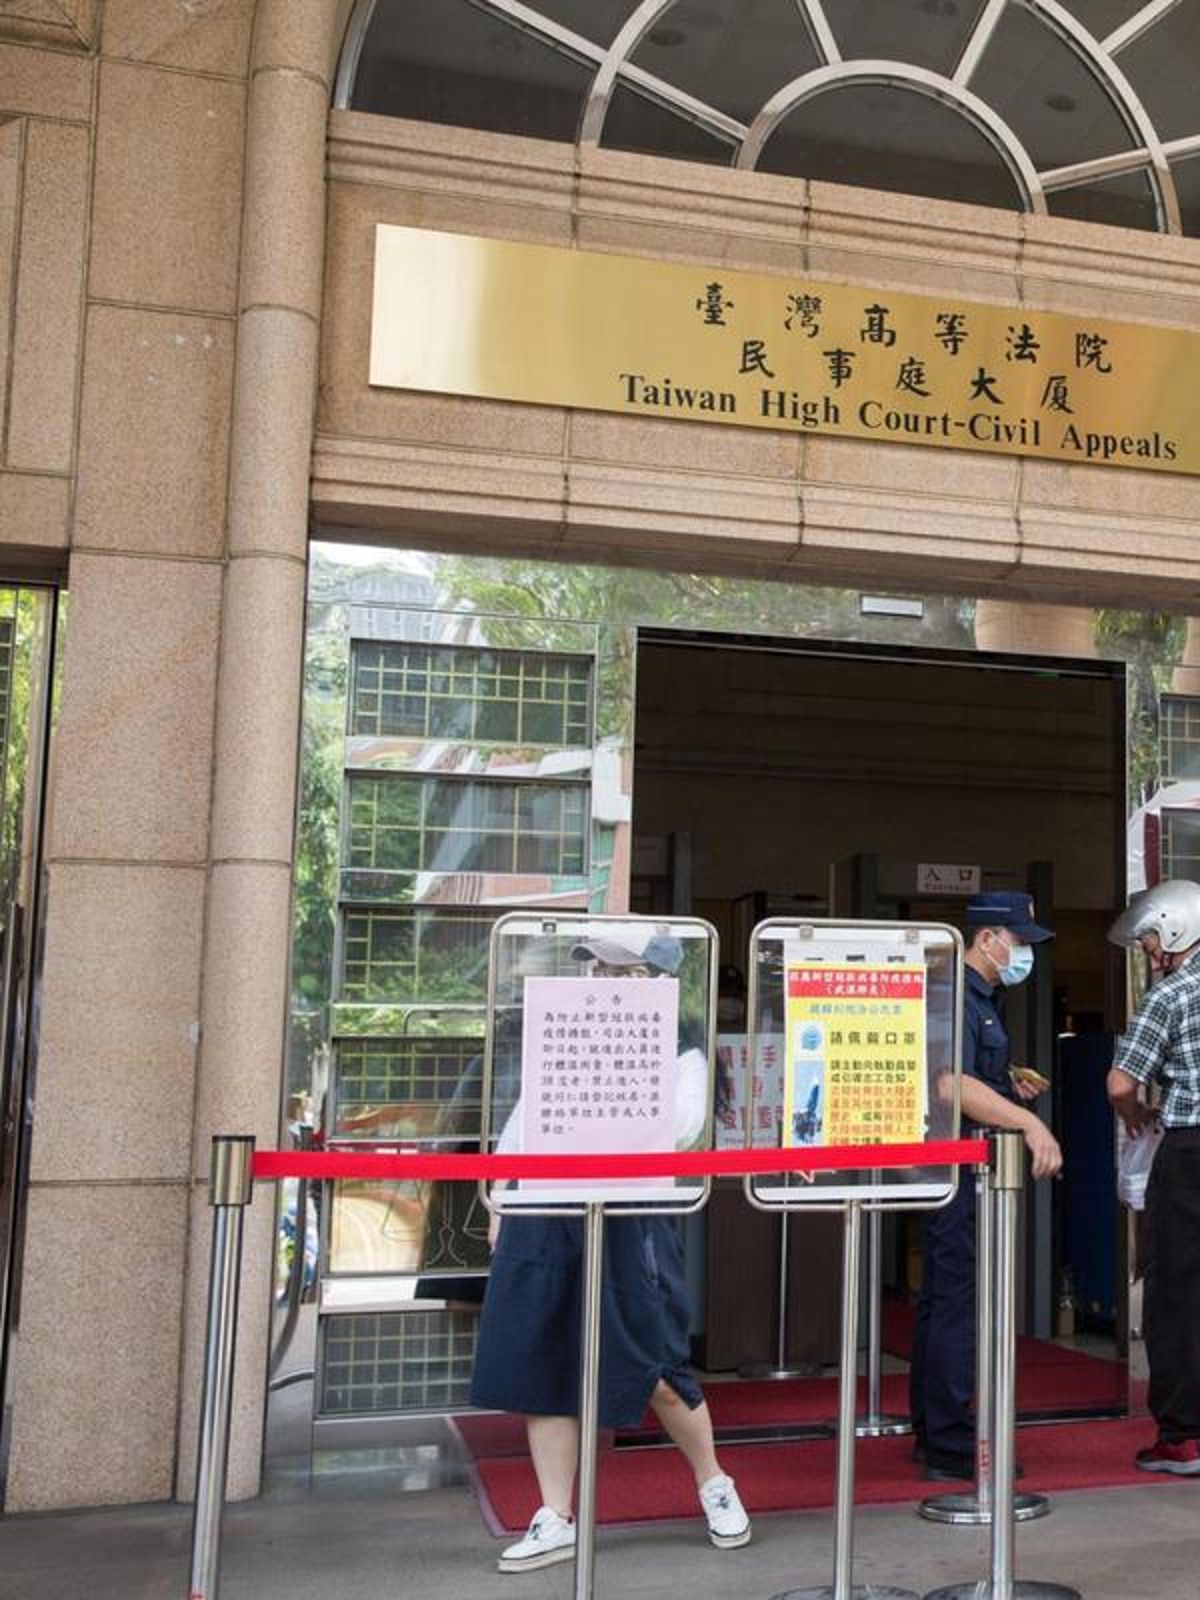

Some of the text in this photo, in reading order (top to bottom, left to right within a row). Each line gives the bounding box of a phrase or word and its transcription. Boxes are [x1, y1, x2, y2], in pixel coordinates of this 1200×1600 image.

[694, 281, 1113, 375] 臺灣高等法院
[619, 373, 1178, 460] Taiwan High Court-Civil Appeals
[925, 867, 973, 881] 入口
